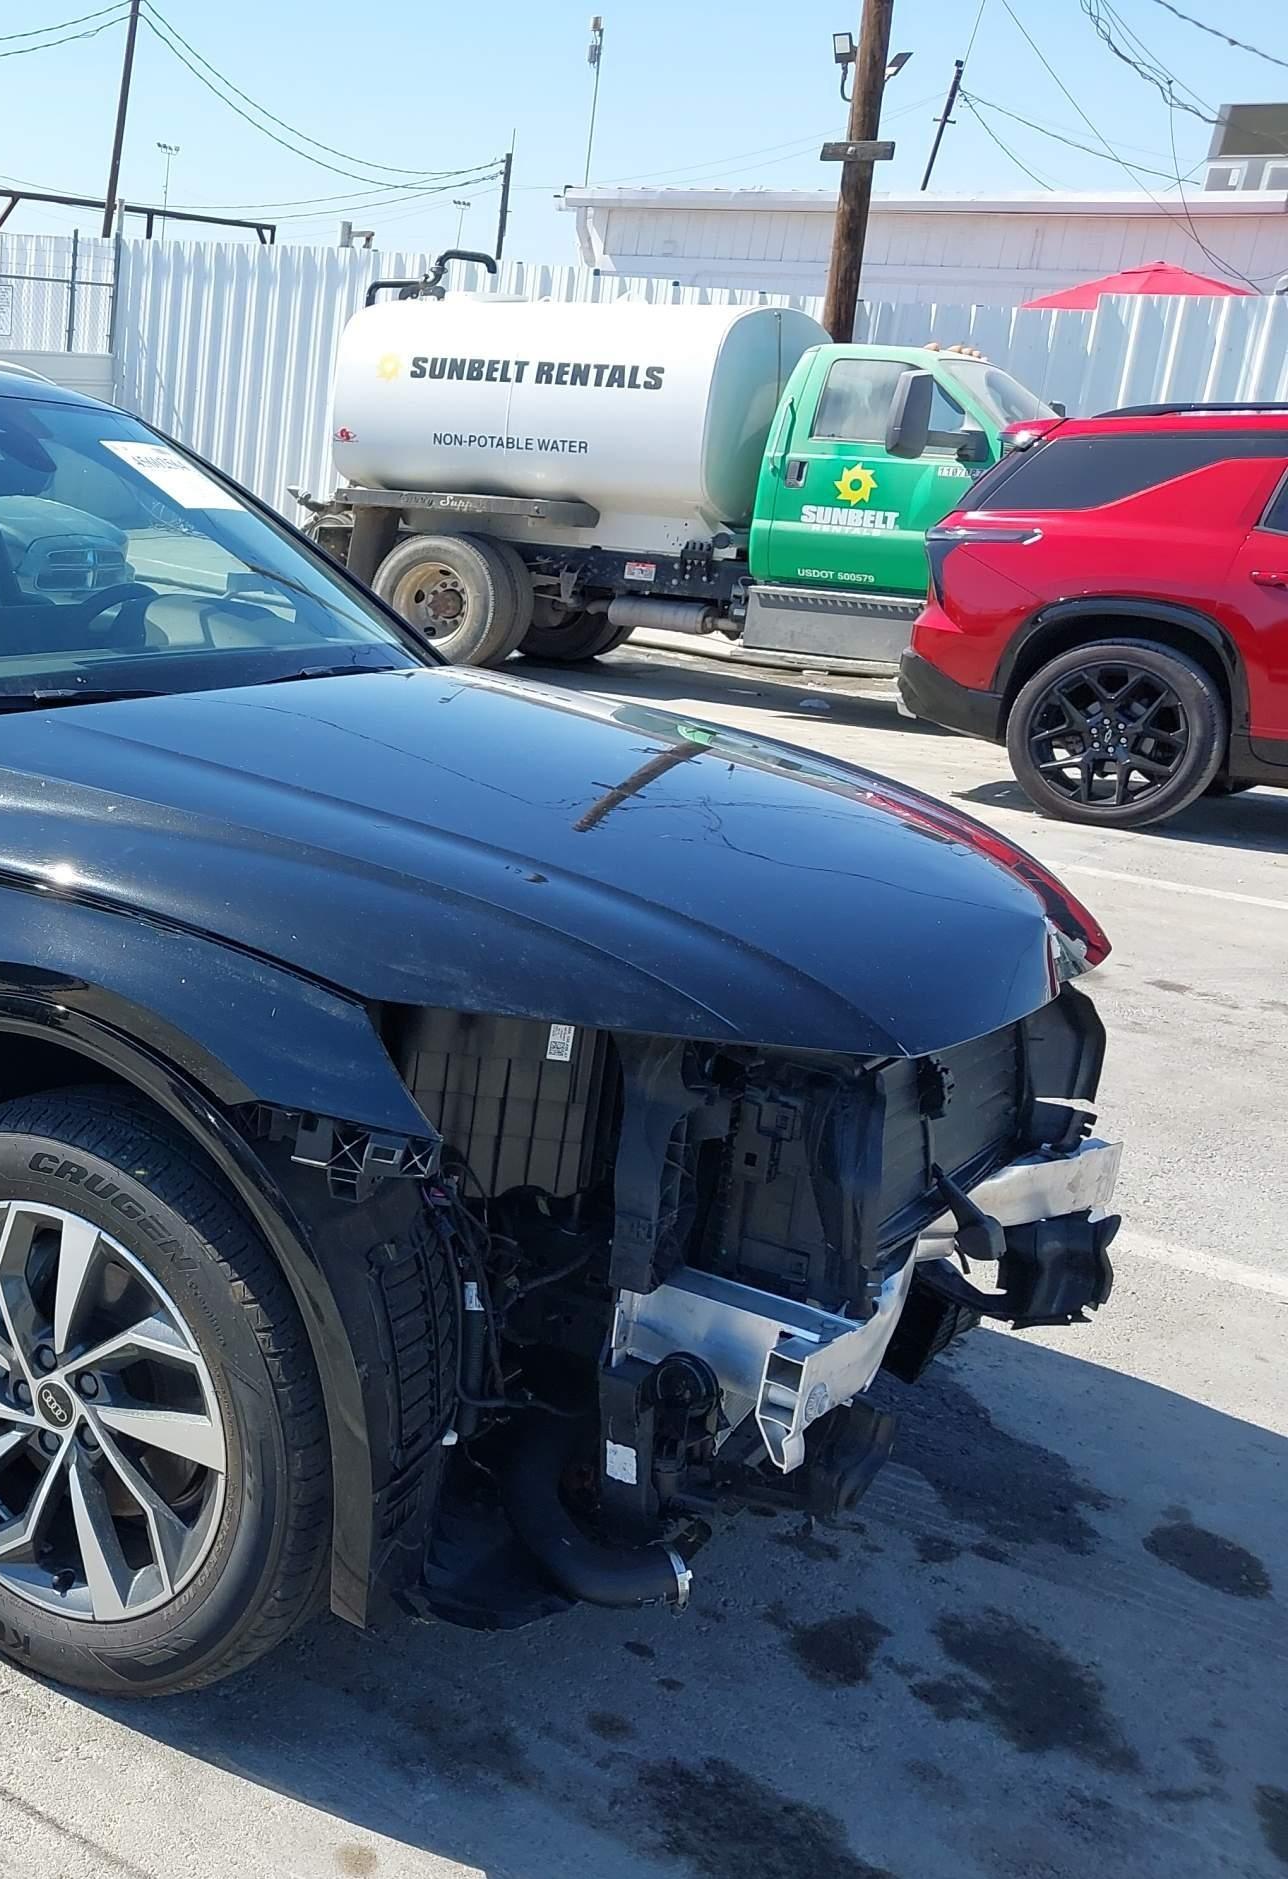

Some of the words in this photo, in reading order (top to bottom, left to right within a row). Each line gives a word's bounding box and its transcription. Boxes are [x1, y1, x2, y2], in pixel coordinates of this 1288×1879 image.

[410, 356, 530, 384] SUNBELT
[535, 361, 665, 390] RENTALS
[432, 432, 534, 451] NON-POTABLE
[536, 438, 589, 454] WATER
[800, 504, 900, 530] SUNBELT
[797, 568, 835, 579] USDOT
[837, 572, 875, 583] 500579
[28, 1152, 200, 1272] CRUGEN
